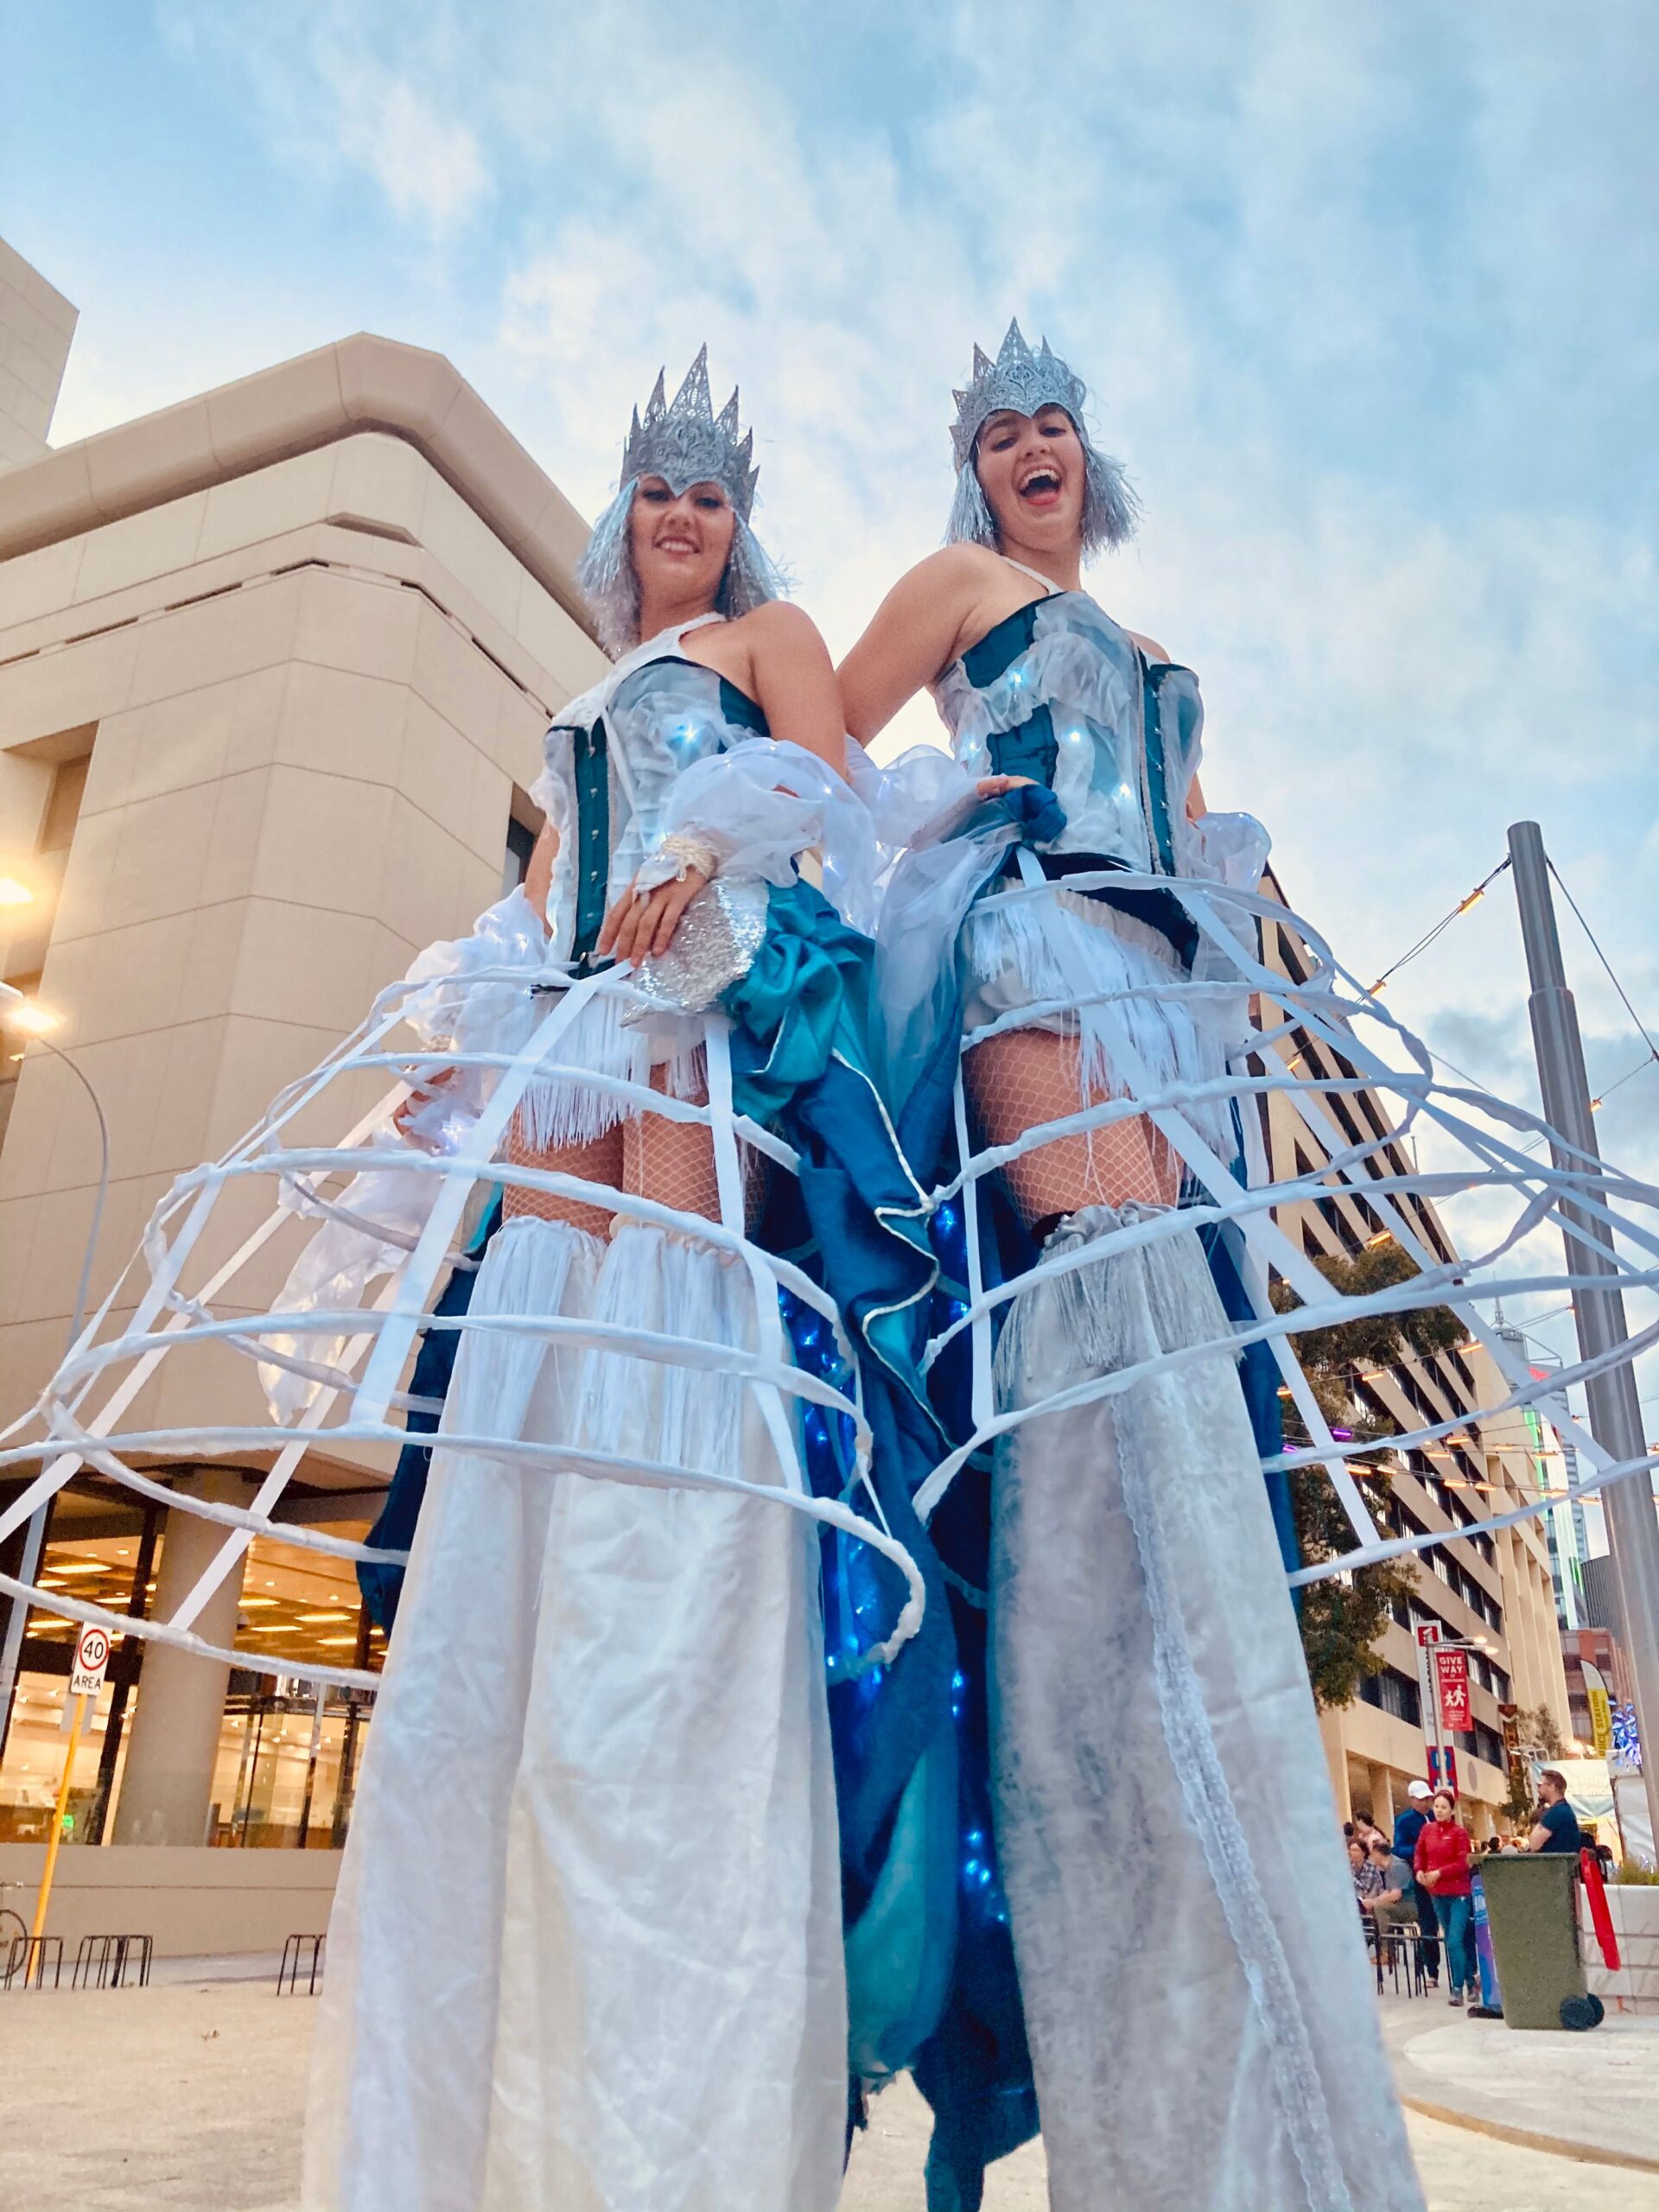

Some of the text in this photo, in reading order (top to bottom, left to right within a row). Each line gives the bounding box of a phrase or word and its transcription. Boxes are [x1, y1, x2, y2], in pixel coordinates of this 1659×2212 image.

[84, 1641, 104, 1659] 40
[1439, 1656, 1462, 1665] GIVE
[1440, 1665, 1463, 1674] WAY
[73, 1675, 101, 1689] AREA
[1591, 1690, 1605, 1729] STATION
